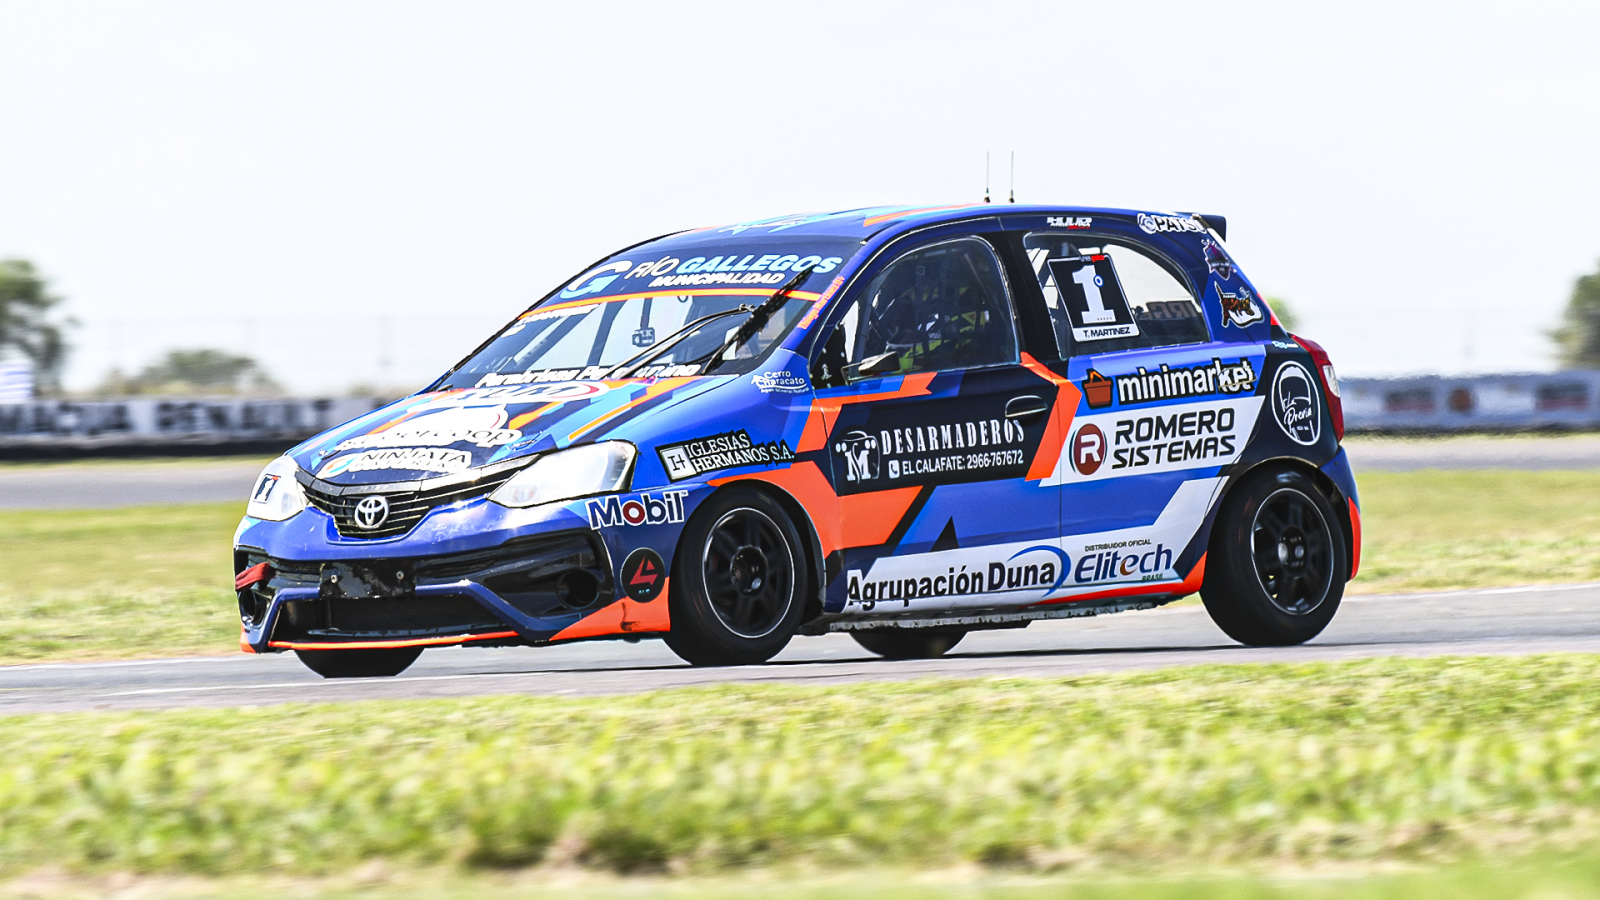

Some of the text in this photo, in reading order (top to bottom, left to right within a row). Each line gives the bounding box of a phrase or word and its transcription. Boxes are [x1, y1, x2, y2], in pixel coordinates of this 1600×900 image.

[625, 253, 844, 280] RÍO GALLEGOS
[648, 271, 787, 288] MUNICIPALIDAD
[1072, 264, 1117, 325] 1
[1091, 326, 1131, 338] MARTINEZ
[764, 370, 791, 378] Cerro
[1118, 359, 1254, 404] minimarket
[880, 418, 1025, 456] DESARMADEROS
[1114, 407, 1236, 445] ROMERO
[684, 433, 751, 458] IGLESIAS
[690, 444, 795, 473] HERMANOS S.A.
[1111, 435, 1236, 470] SISTEMAS
[902, 449, 1024, 475] EL CALAFATE: 2966-767672
[587, 492, 684, 529] Mobil
[1084, 538, 1152, 552] DISTRIBUIDOR OFICIAL
[1074, 543, 1173, 583] Elitech
[847, 559, 1056, 611] Agrupación Duna
